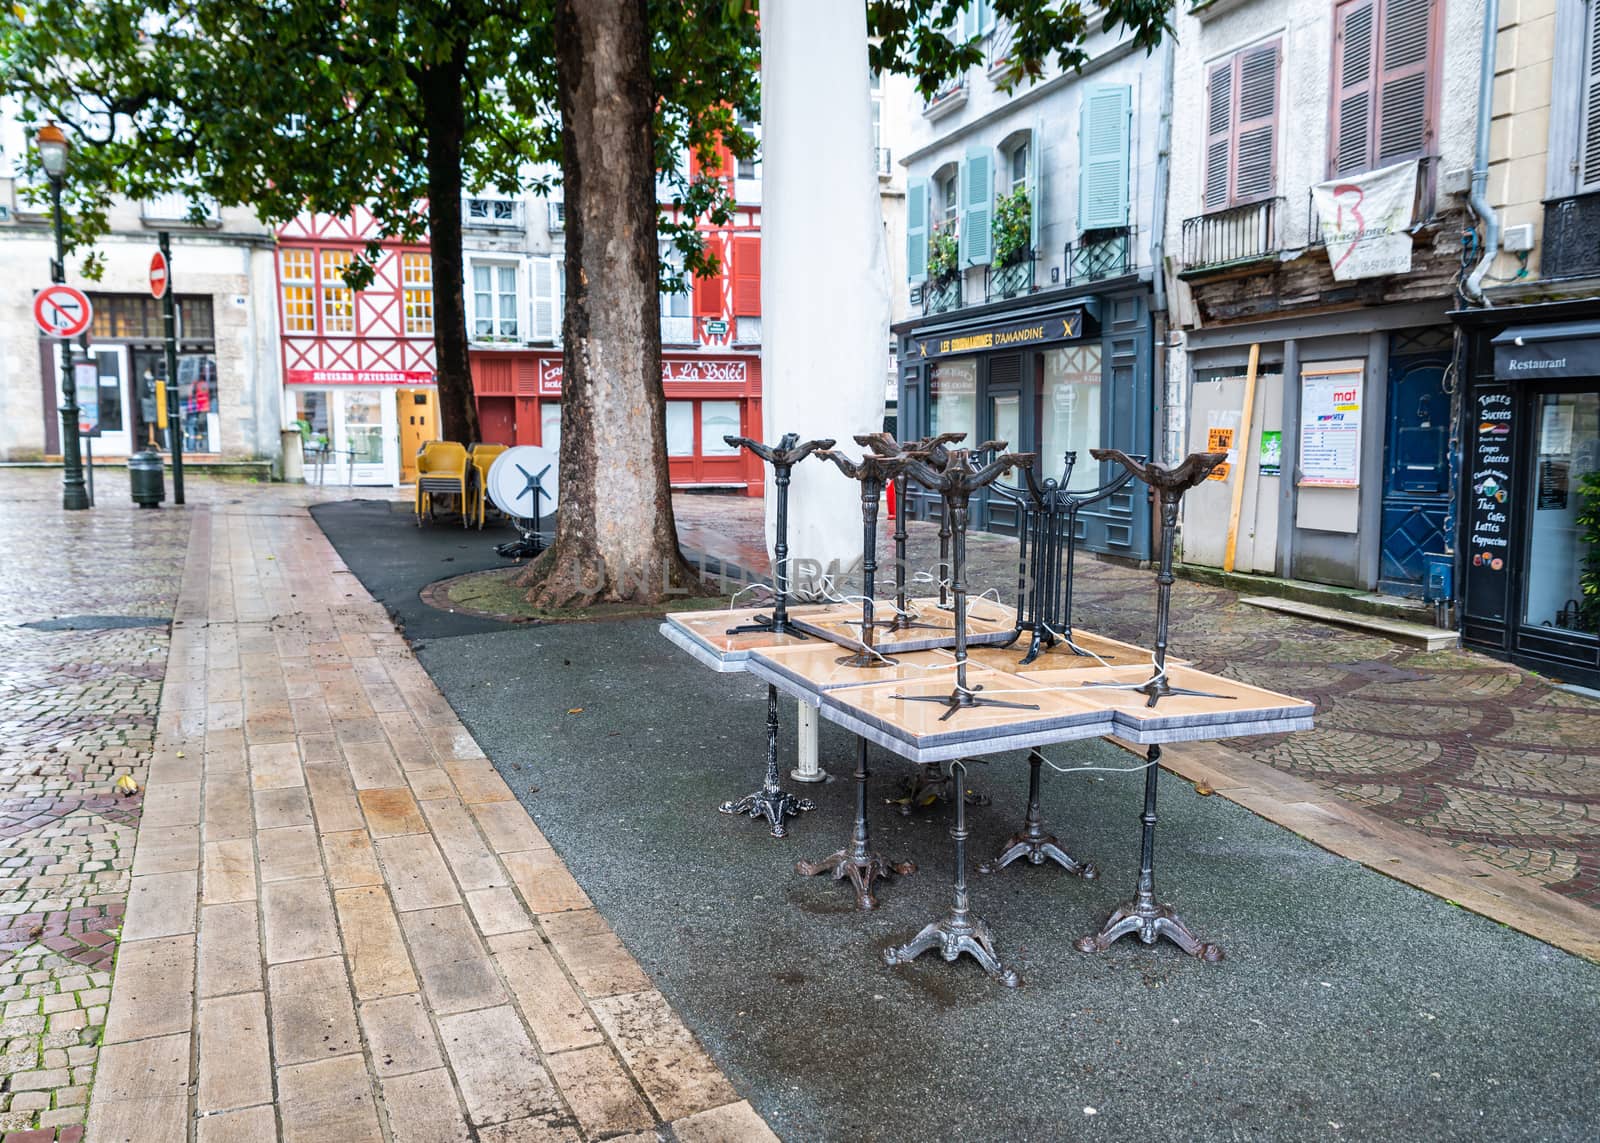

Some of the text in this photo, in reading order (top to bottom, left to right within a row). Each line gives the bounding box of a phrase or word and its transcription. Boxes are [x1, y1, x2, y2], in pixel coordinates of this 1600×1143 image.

[995, 327, 1045, 345] D'AMANDINE
[1508, 358, 1567, 371] Restaurant
[1333, 389, 1357, 402] mat
